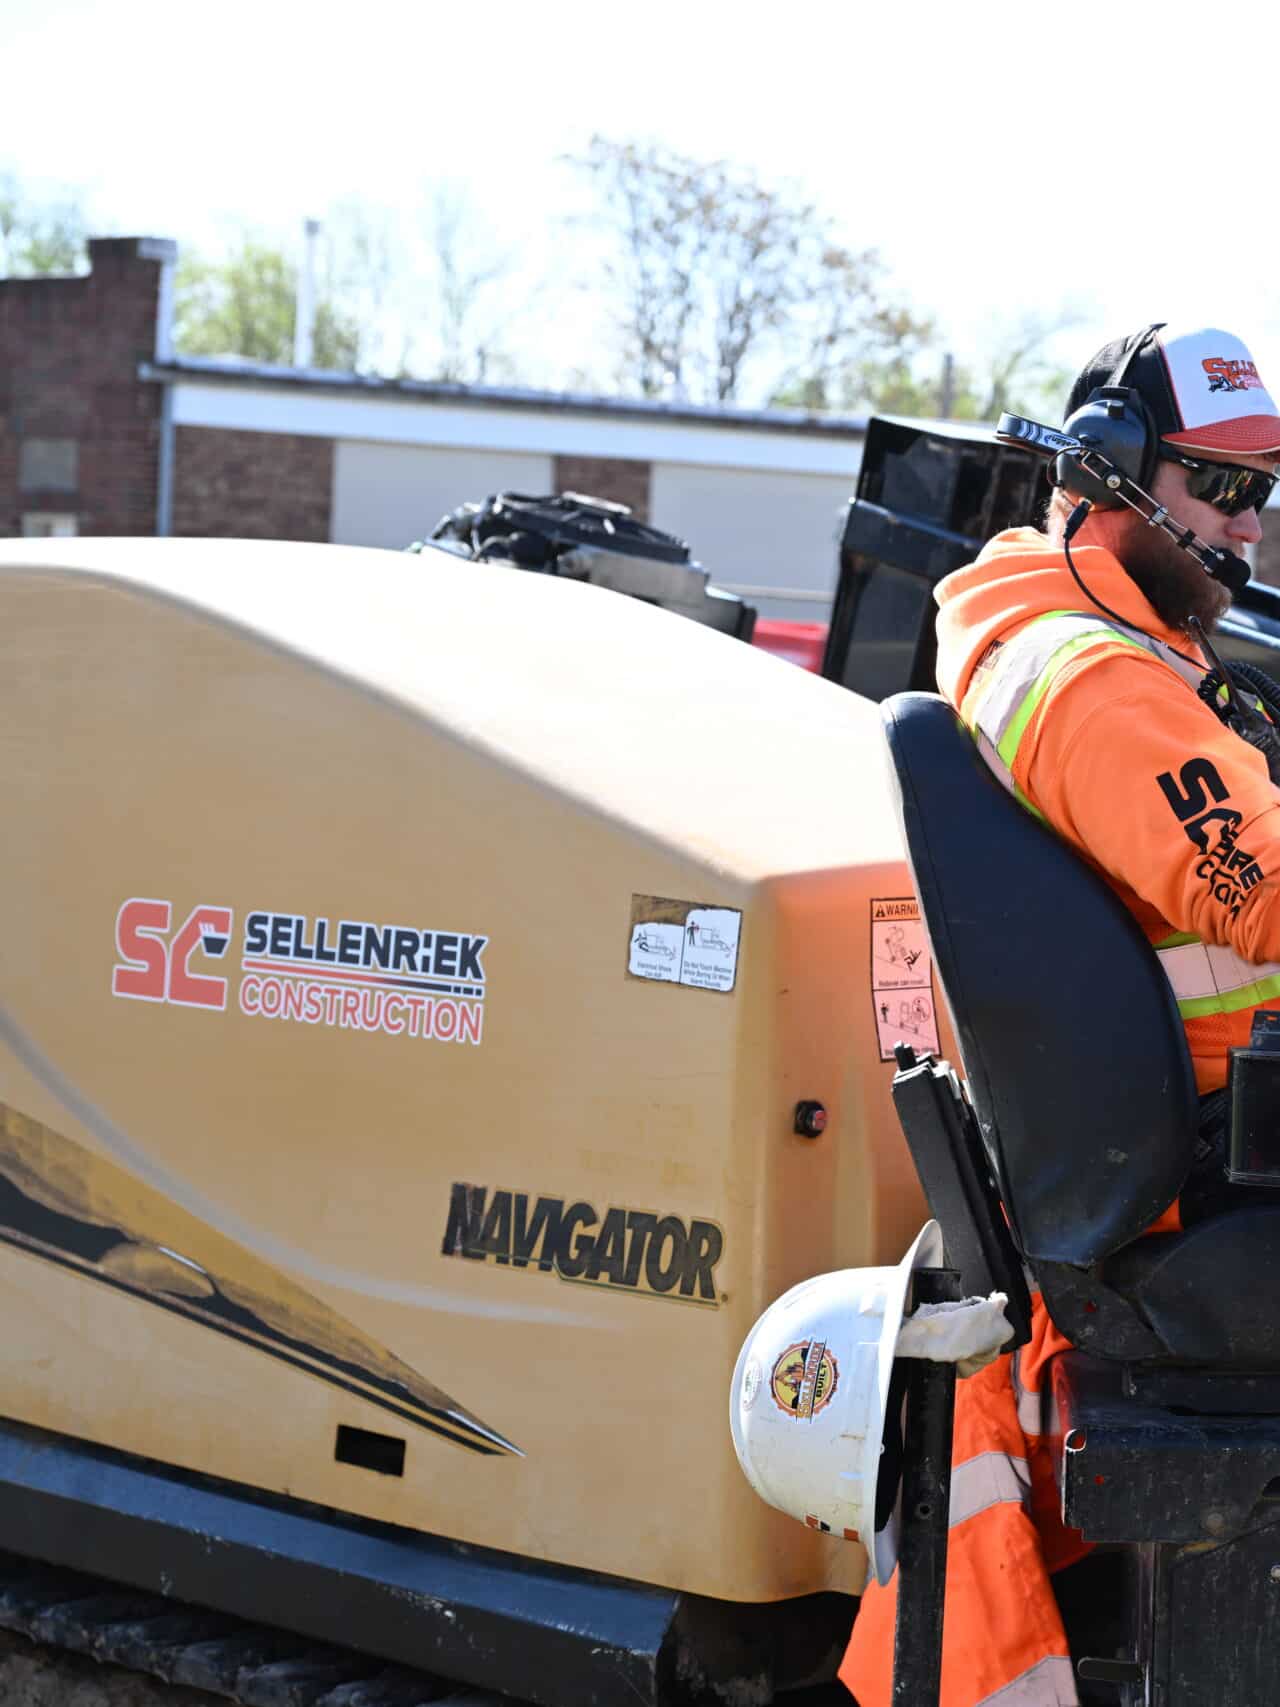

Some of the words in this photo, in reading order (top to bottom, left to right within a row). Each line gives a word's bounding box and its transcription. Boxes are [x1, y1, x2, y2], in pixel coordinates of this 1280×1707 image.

[113, 898, 232, 1010] SC
[245, 912, 487, 981] SELLENRIEK
[240, 976, 483, 1043] CONSTRUCTION
[441, 1182, 723, 1300] NAVIGATOR
[815, 1362, 827, 1398] BUILT
